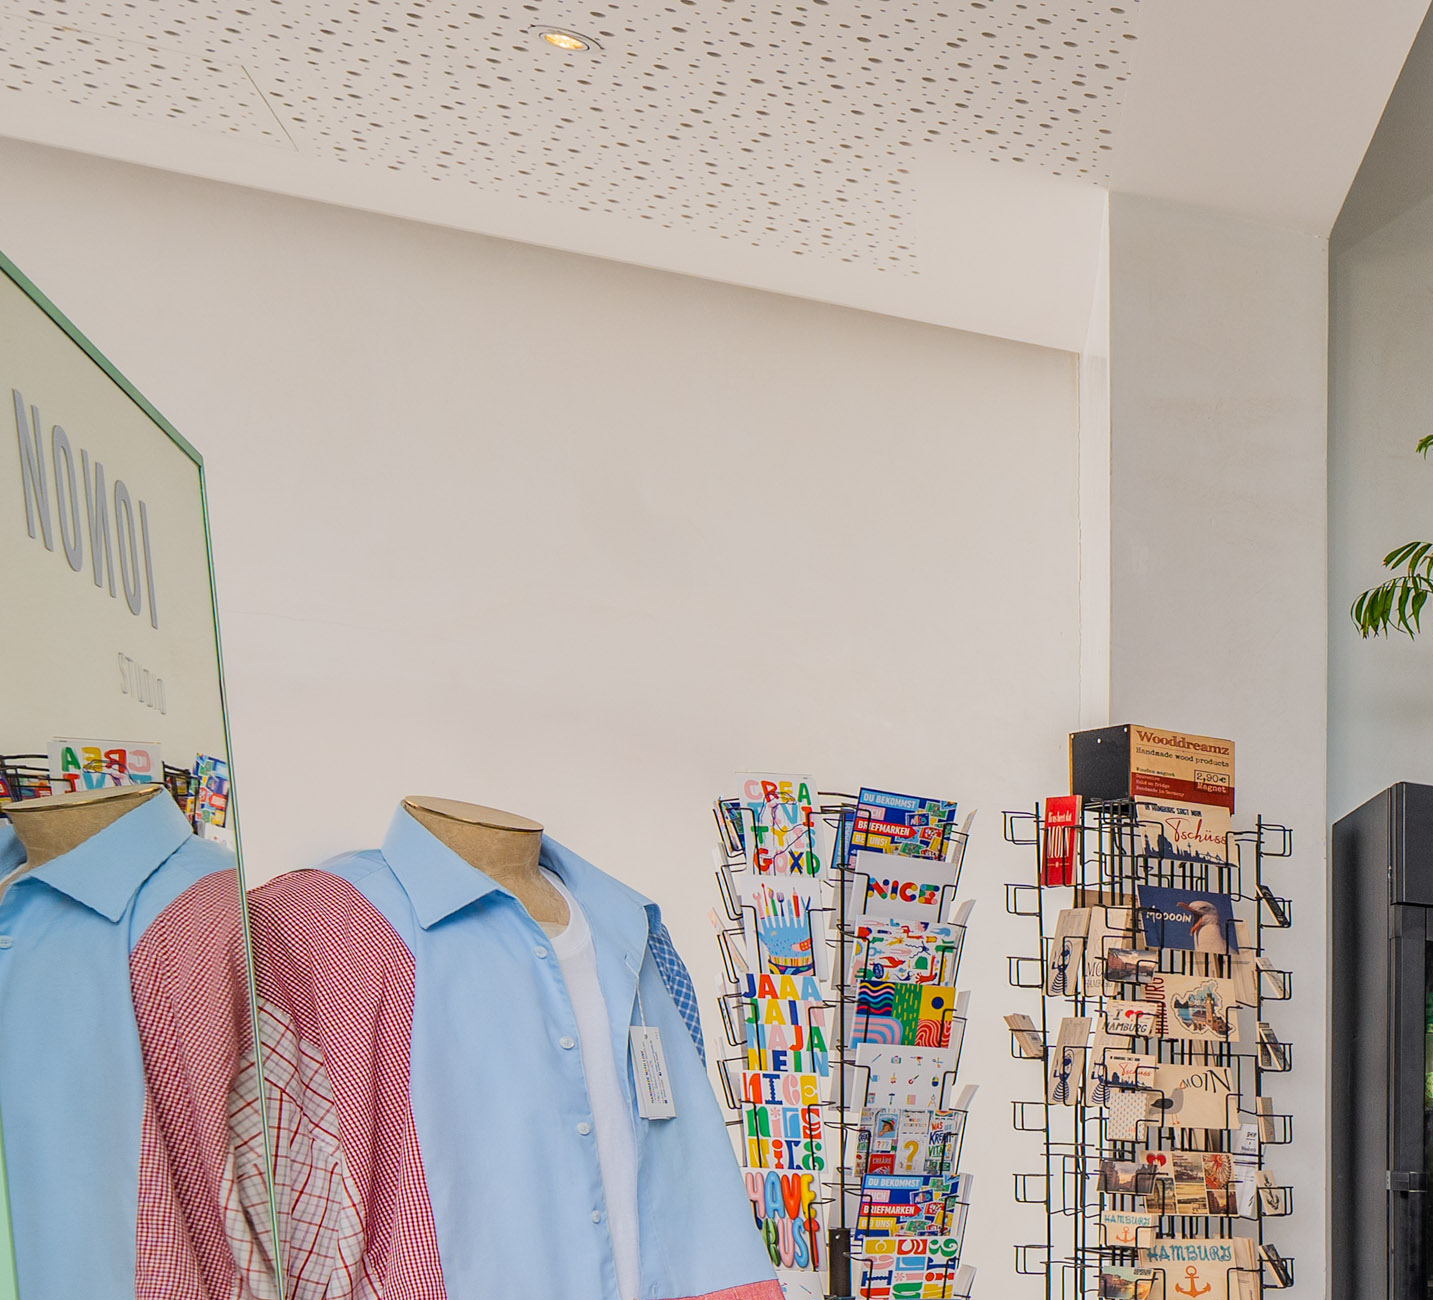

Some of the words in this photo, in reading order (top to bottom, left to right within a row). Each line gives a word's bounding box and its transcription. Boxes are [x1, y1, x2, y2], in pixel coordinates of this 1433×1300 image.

[1136, 730, 1230, 756] Wooddreamz
[1136, 747, 1173, 759] Handmade
[1175, 753, 1194, 762] wood
[1195, 757, 1230, 768] products
[743, 780, 812, 806] CREA
[1196, 782, 1227, 793] Magnet
[863, 793, 874, 802] DU
[876, 795, 917, 809] BEKOMMST
[857, 821, 911, 836] BRIEFMARKEN
[1165, 818, 1227, 845] Tschüss
[867, 877, 941, 906] NICE
[742, 973, 823, 1001] JAAA
[1102, 1020, 1148, 1033] HAMBURG
[1182, 1068, 1232, 1094] MOIN
[868, 1178, 878, 1186] DU
[880, 1178, 920, 1187] BEKOMMST
[745, 1171, 816, 1220] HAVE
[863, 1206, 915, 1216] BRIEFMARKEN
[1146, 1244, 1233, 1263] HAMBURG
